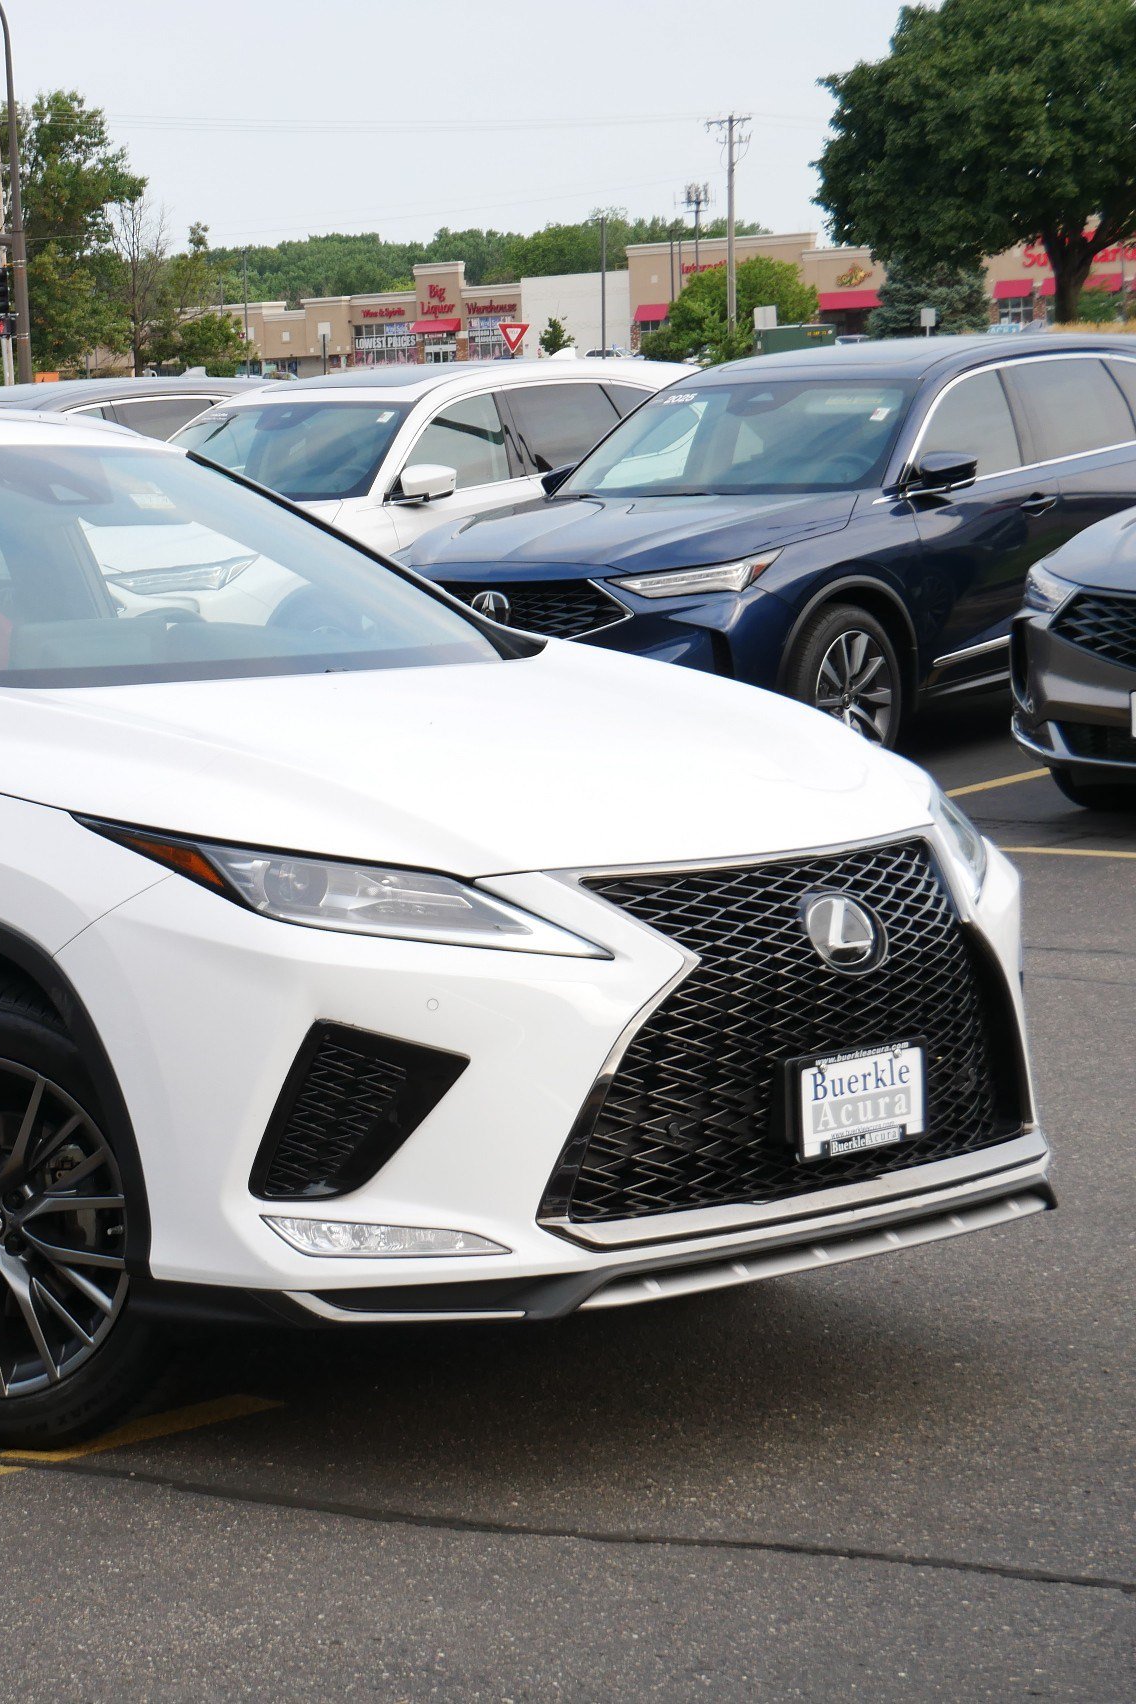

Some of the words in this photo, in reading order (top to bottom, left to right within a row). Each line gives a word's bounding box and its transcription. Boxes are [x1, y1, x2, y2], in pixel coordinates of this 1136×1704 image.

[428, 284, 446, 302] Big
[420, 302, 455, 318] Liquor
[466, 300, 517, 314] Warehouse
[356, 337, 386, 349] LOWEST
[387, 335, 416, 348] PRICES
[664, 393, 698, 404] 2025
[815, 1041, 909, 1066] www.buerkleacura.com
[811, 1057, 910, 1101] Buerkle
[817, 1092, 908, 1131] Acura
